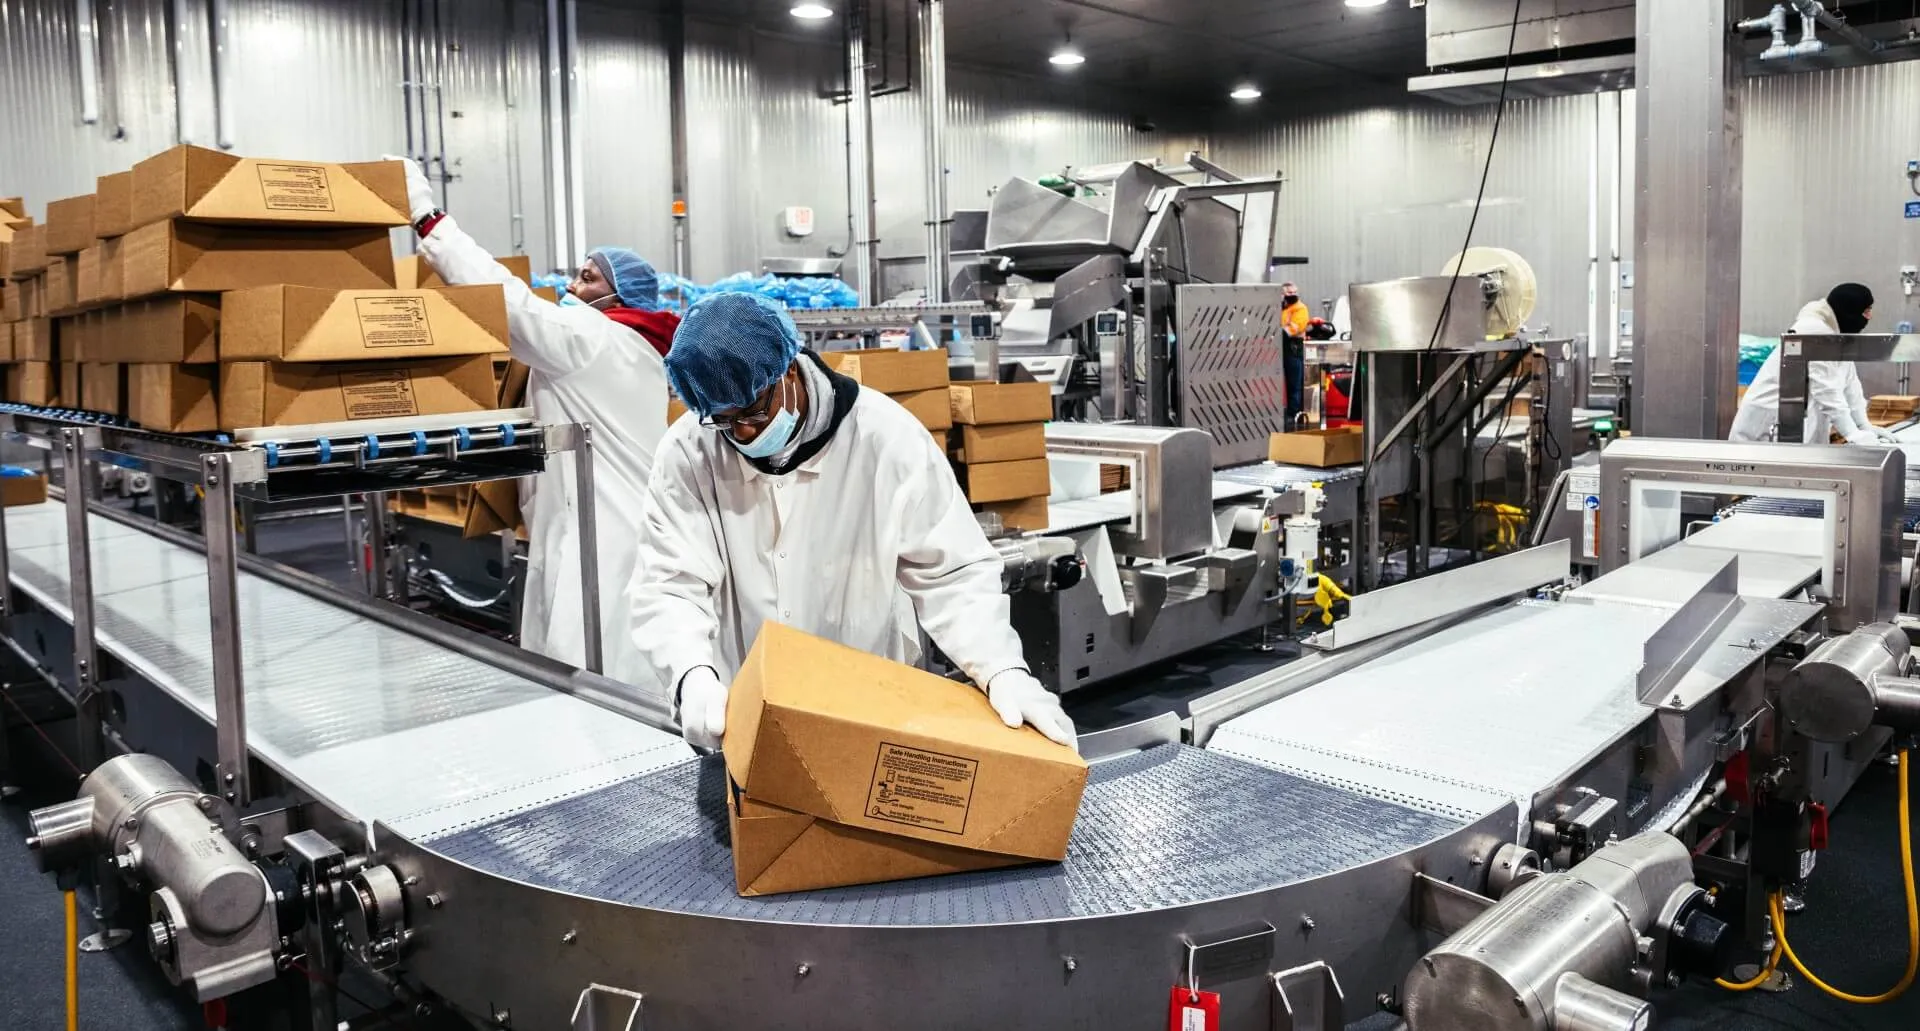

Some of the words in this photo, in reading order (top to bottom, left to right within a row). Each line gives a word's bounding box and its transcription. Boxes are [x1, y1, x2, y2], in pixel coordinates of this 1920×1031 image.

[1713, 463, 1725, 471] NO
[1731, 463, 1747, 472] LIFT
[889, 748, 903, 756] Safe
[904, 751, 931, 762] Handling
[932, 756, 967, 768] Instructions
